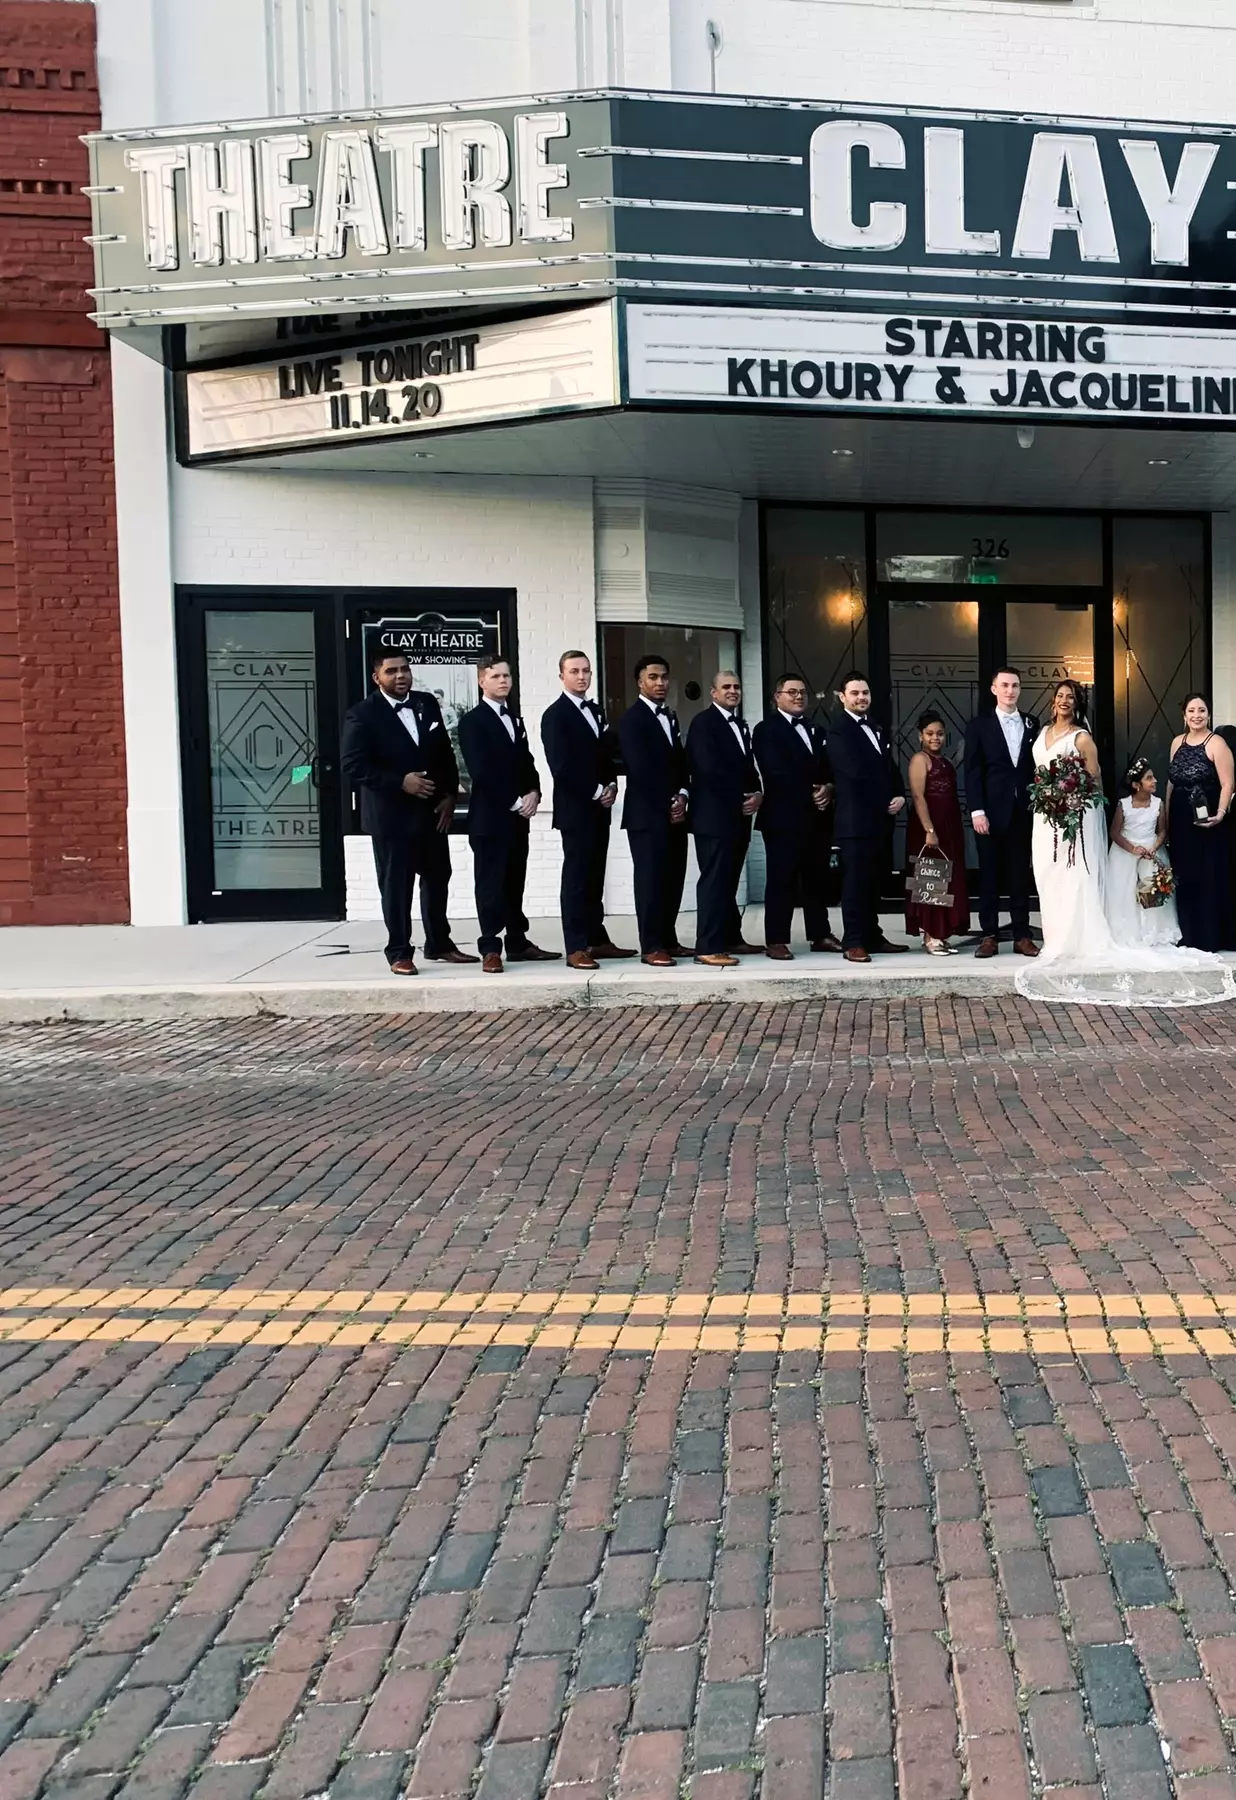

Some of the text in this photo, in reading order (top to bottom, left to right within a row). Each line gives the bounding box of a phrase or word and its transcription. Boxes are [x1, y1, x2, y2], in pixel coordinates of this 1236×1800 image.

[124, 111, 575, 271] THEATRE
[809, 120, 1221, 267] CLAY
[885, 317, 1106, 364] STARRING
[278, 333, 480, 399] LIVE TONIGHT
[726, 356, 915, 404] KHOURY
[934, 365, 967, 404] &
[330, 381, 442, 430] 11.14.20
[972, 538, 1010, 558] 326
[381, 633, 484, 648] CLAY THEATRE
[407, 656, 467, 665] OW SHOWING
[233, 663, 289, 677] CLAY
[911, 664, 958, 677] CLAY
[1027, 666, 1072, 678] CLAY
[214, 819, 320, 836] THEATRE
[926, 882, 935, 891] to
